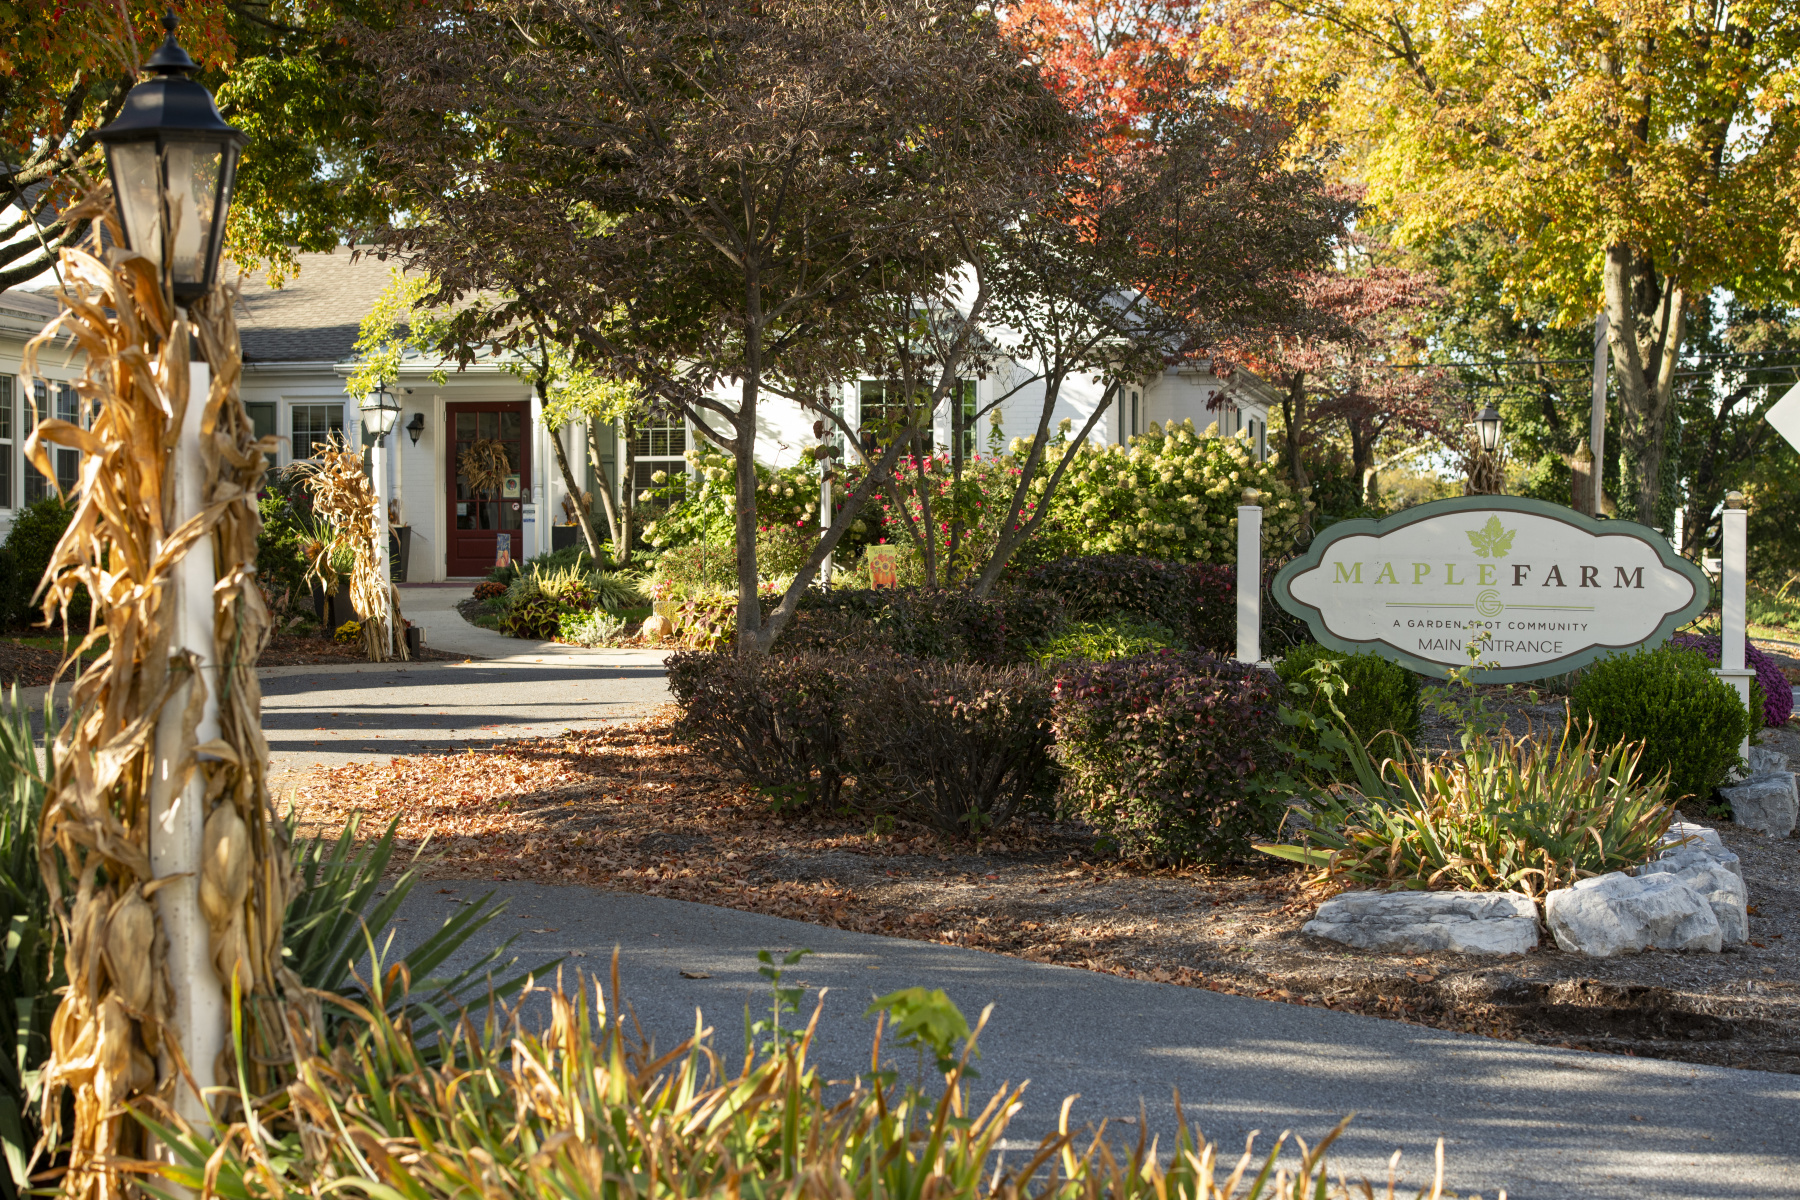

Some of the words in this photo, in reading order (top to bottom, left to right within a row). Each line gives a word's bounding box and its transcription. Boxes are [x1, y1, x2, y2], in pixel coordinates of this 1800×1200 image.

[1333, 561, 1498, 586] MAPLE
[1511, 564, 1645, 588] FARM
[1393, 619, 1401, 628] A
[1407, 619, 1461, 629] GARDEN
[1508, 621, 1588, 632] COMMUNITY
[1418, 638, 1461, 651] MAIN
